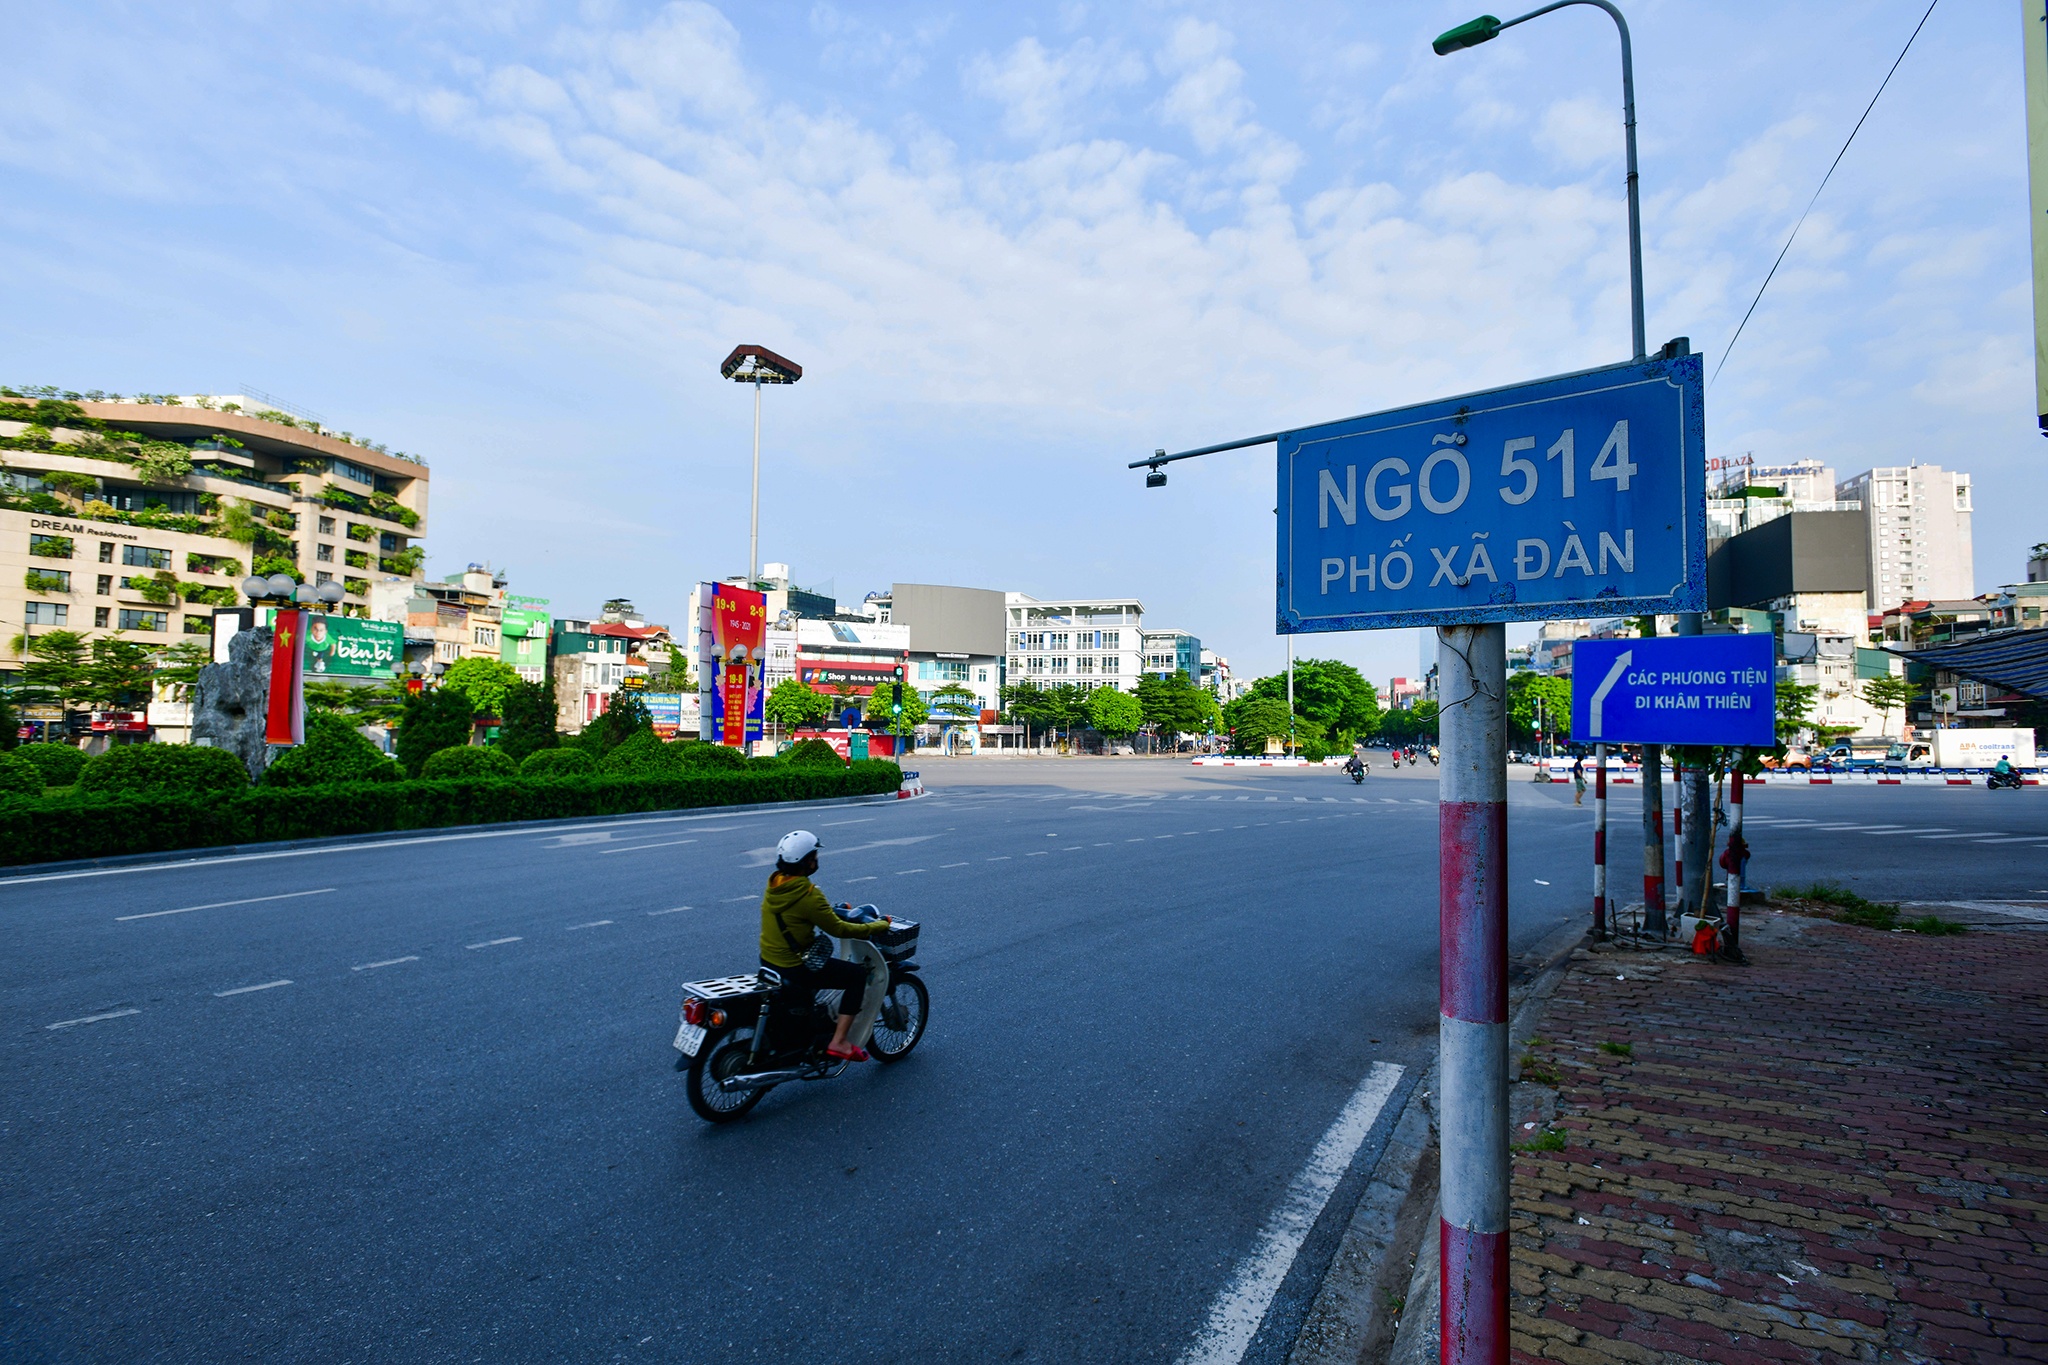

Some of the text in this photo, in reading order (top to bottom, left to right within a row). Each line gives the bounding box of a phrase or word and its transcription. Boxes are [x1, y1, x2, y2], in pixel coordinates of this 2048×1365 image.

[1721, 456, 1755, 469] PLAZA
[1318, 419, 1638, 529] NGÕ 514
[31, 519, 138, 541] DREAM Residences
[1321, 521, 1634, 595] PHỐ XÃ ĐÀN
[805, 670, 846, 684] FPT Shop
[1627, 667, 1767, 688] CÁC PHƯƠNG TIỆN
[1635, 692, 1751, 709] ĐI KHÂM THIÊN
